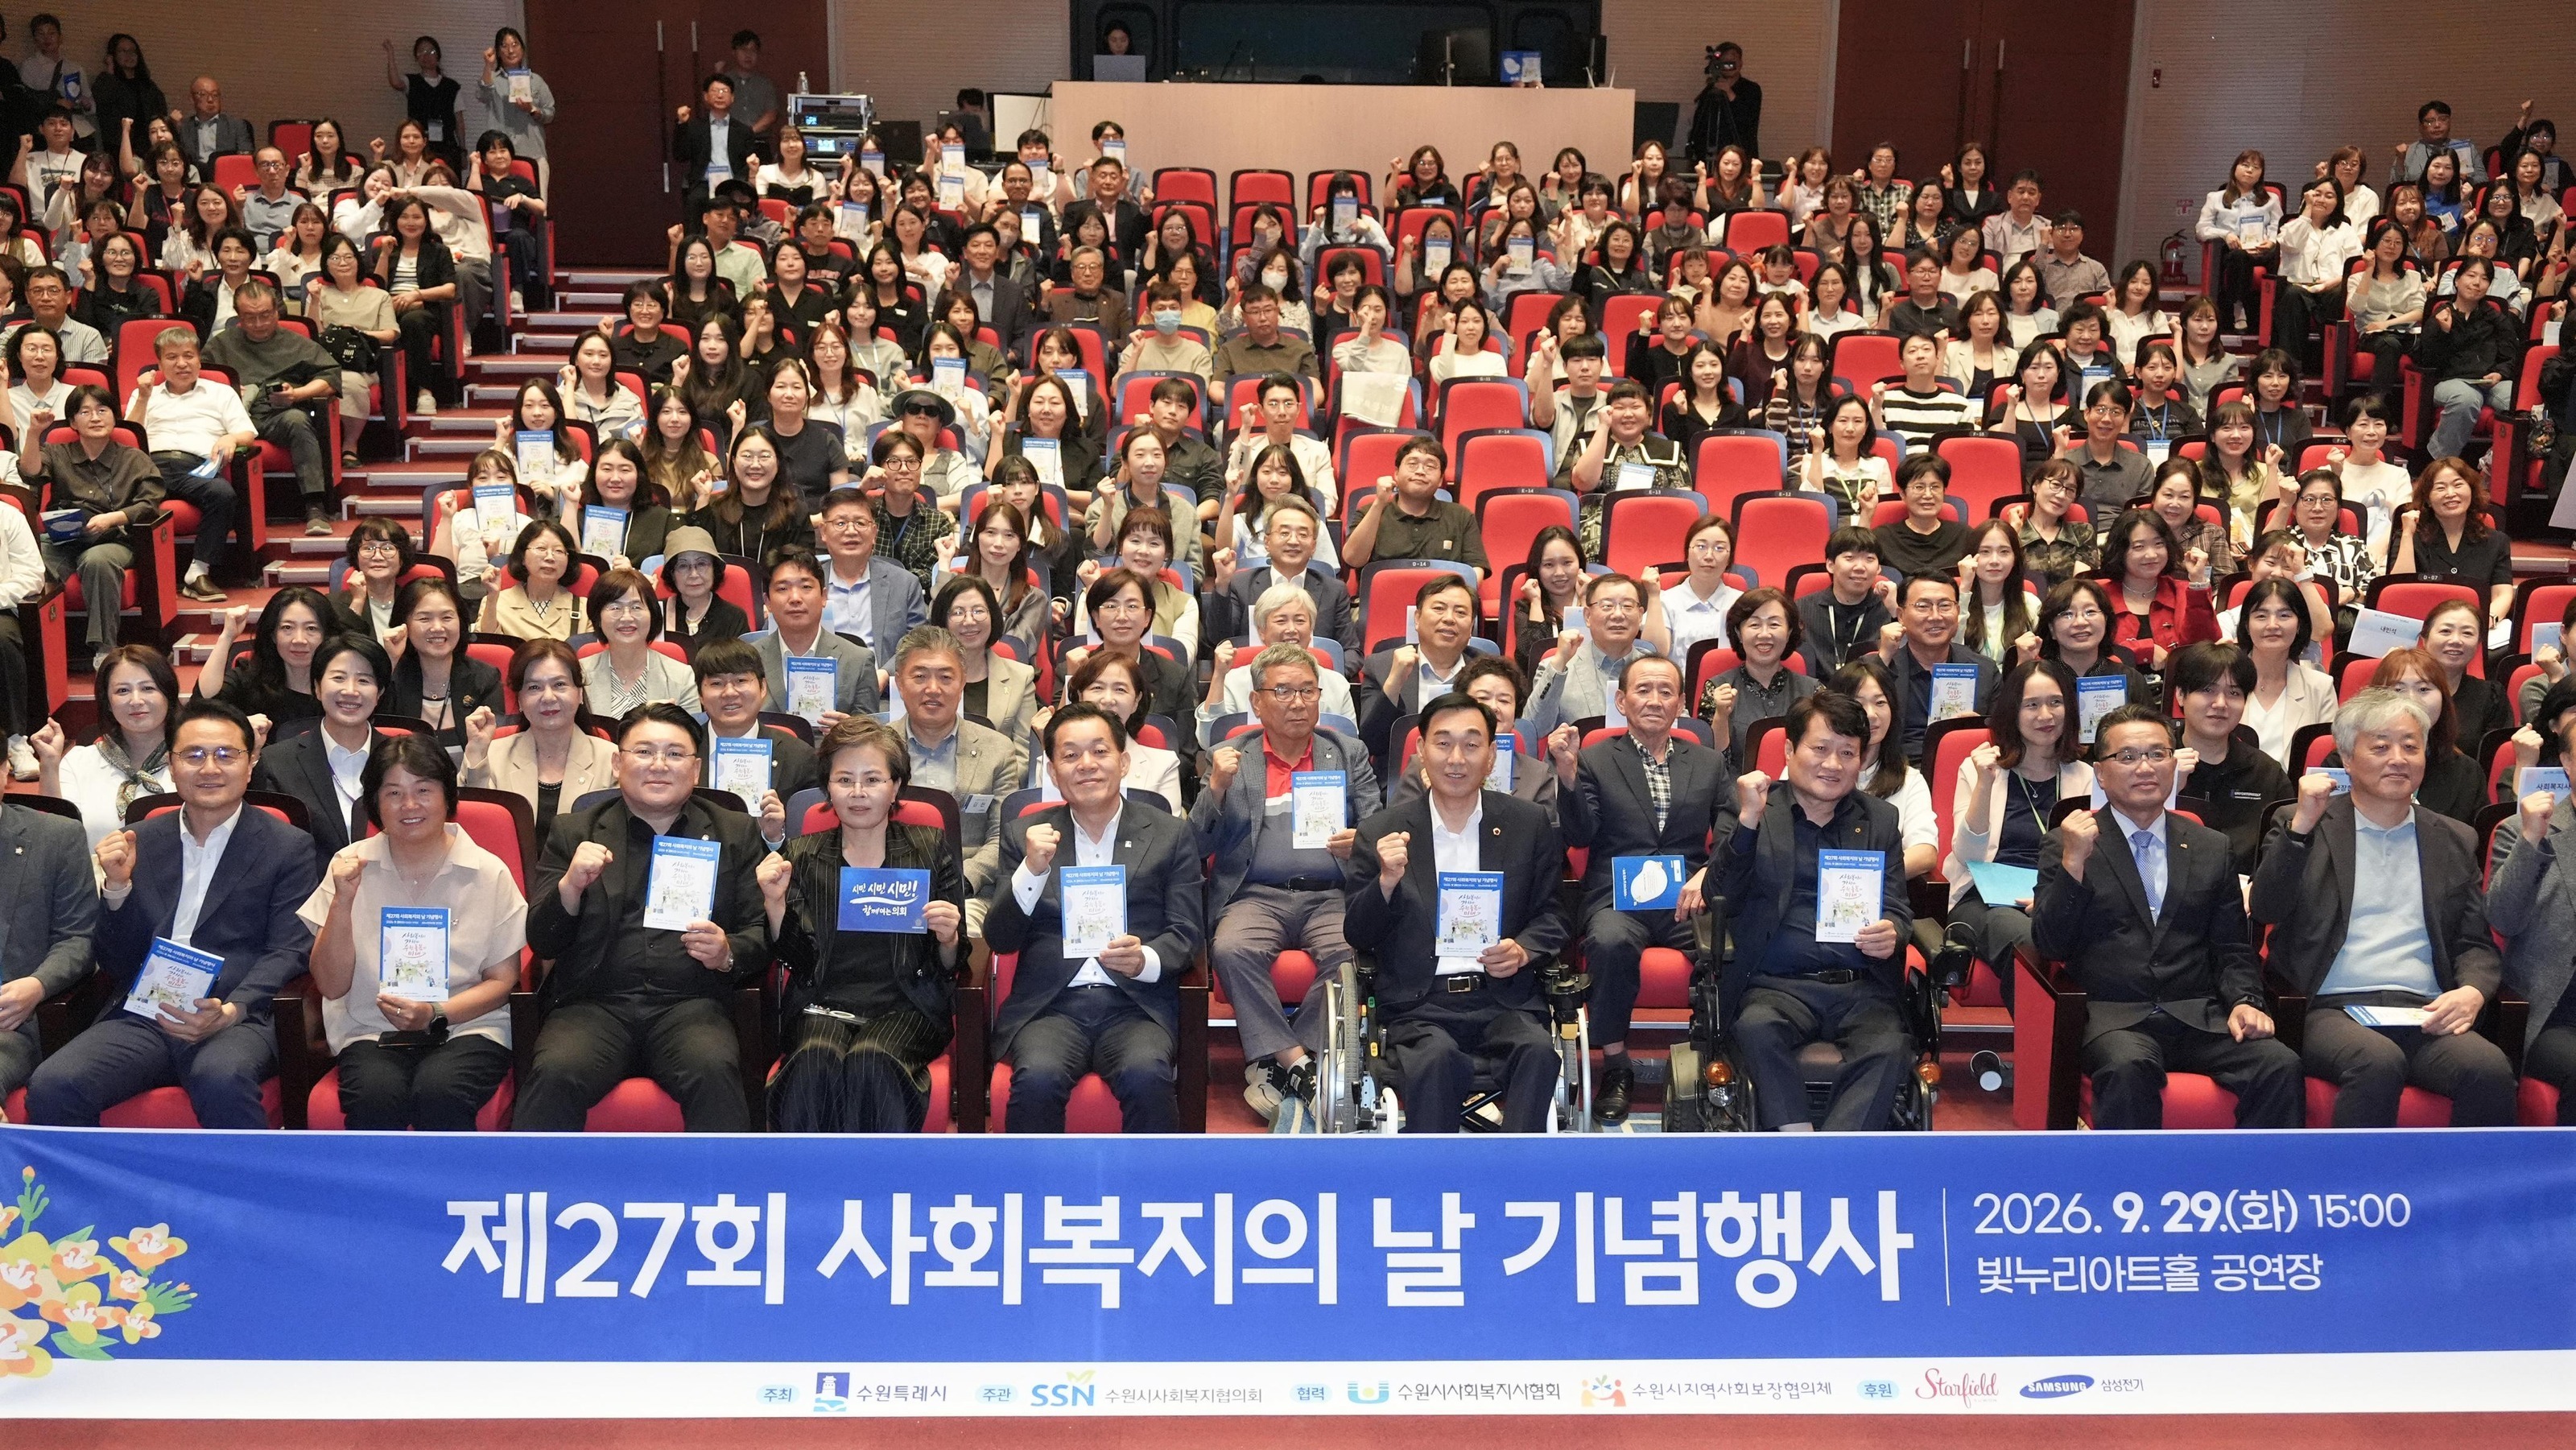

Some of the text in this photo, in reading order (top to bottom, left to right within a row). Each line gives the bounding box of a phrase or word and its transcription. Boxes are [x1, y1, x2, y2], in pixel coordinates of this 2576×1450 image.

[2380, 625, 2397, 635] 내빈석
[852, 880, 918, 899] 시민 시민 시민!
[1974, 1188, 2411, 1234] 2026. 9. 29.(화) 15:00
[441, 1190, 1914, 1308] 제27회 사회복지의 날 기념행사
[1977, 1253, 2323, 1295] 빛누리아트홀 공연장
[763, 1387, 792, 1402] 주최
[857, 1385, 947, 1402] 수원특례시
[982, 1387, 1011, 1402] 주관
[1297, 1386, 1325, 1401] 협력
[1397, 1382, 1560, 1401] 수원시사회복지사협회
[1632, 1382, 1832, 1400] 수원시지역사회보장협의체
[1864, 1382, 1893, 1398] 후원
[1915, 1368, 1999, 1409] Starfield
[2028, 1381, 2089, 1393] SAMSUNG
[2100, 1378, 2145, 1393] 삼성전기
[1030, 1384, 1095, 1407] SSN
[1104, 1386, 1262, 1404] 수원시사회복지협의회
